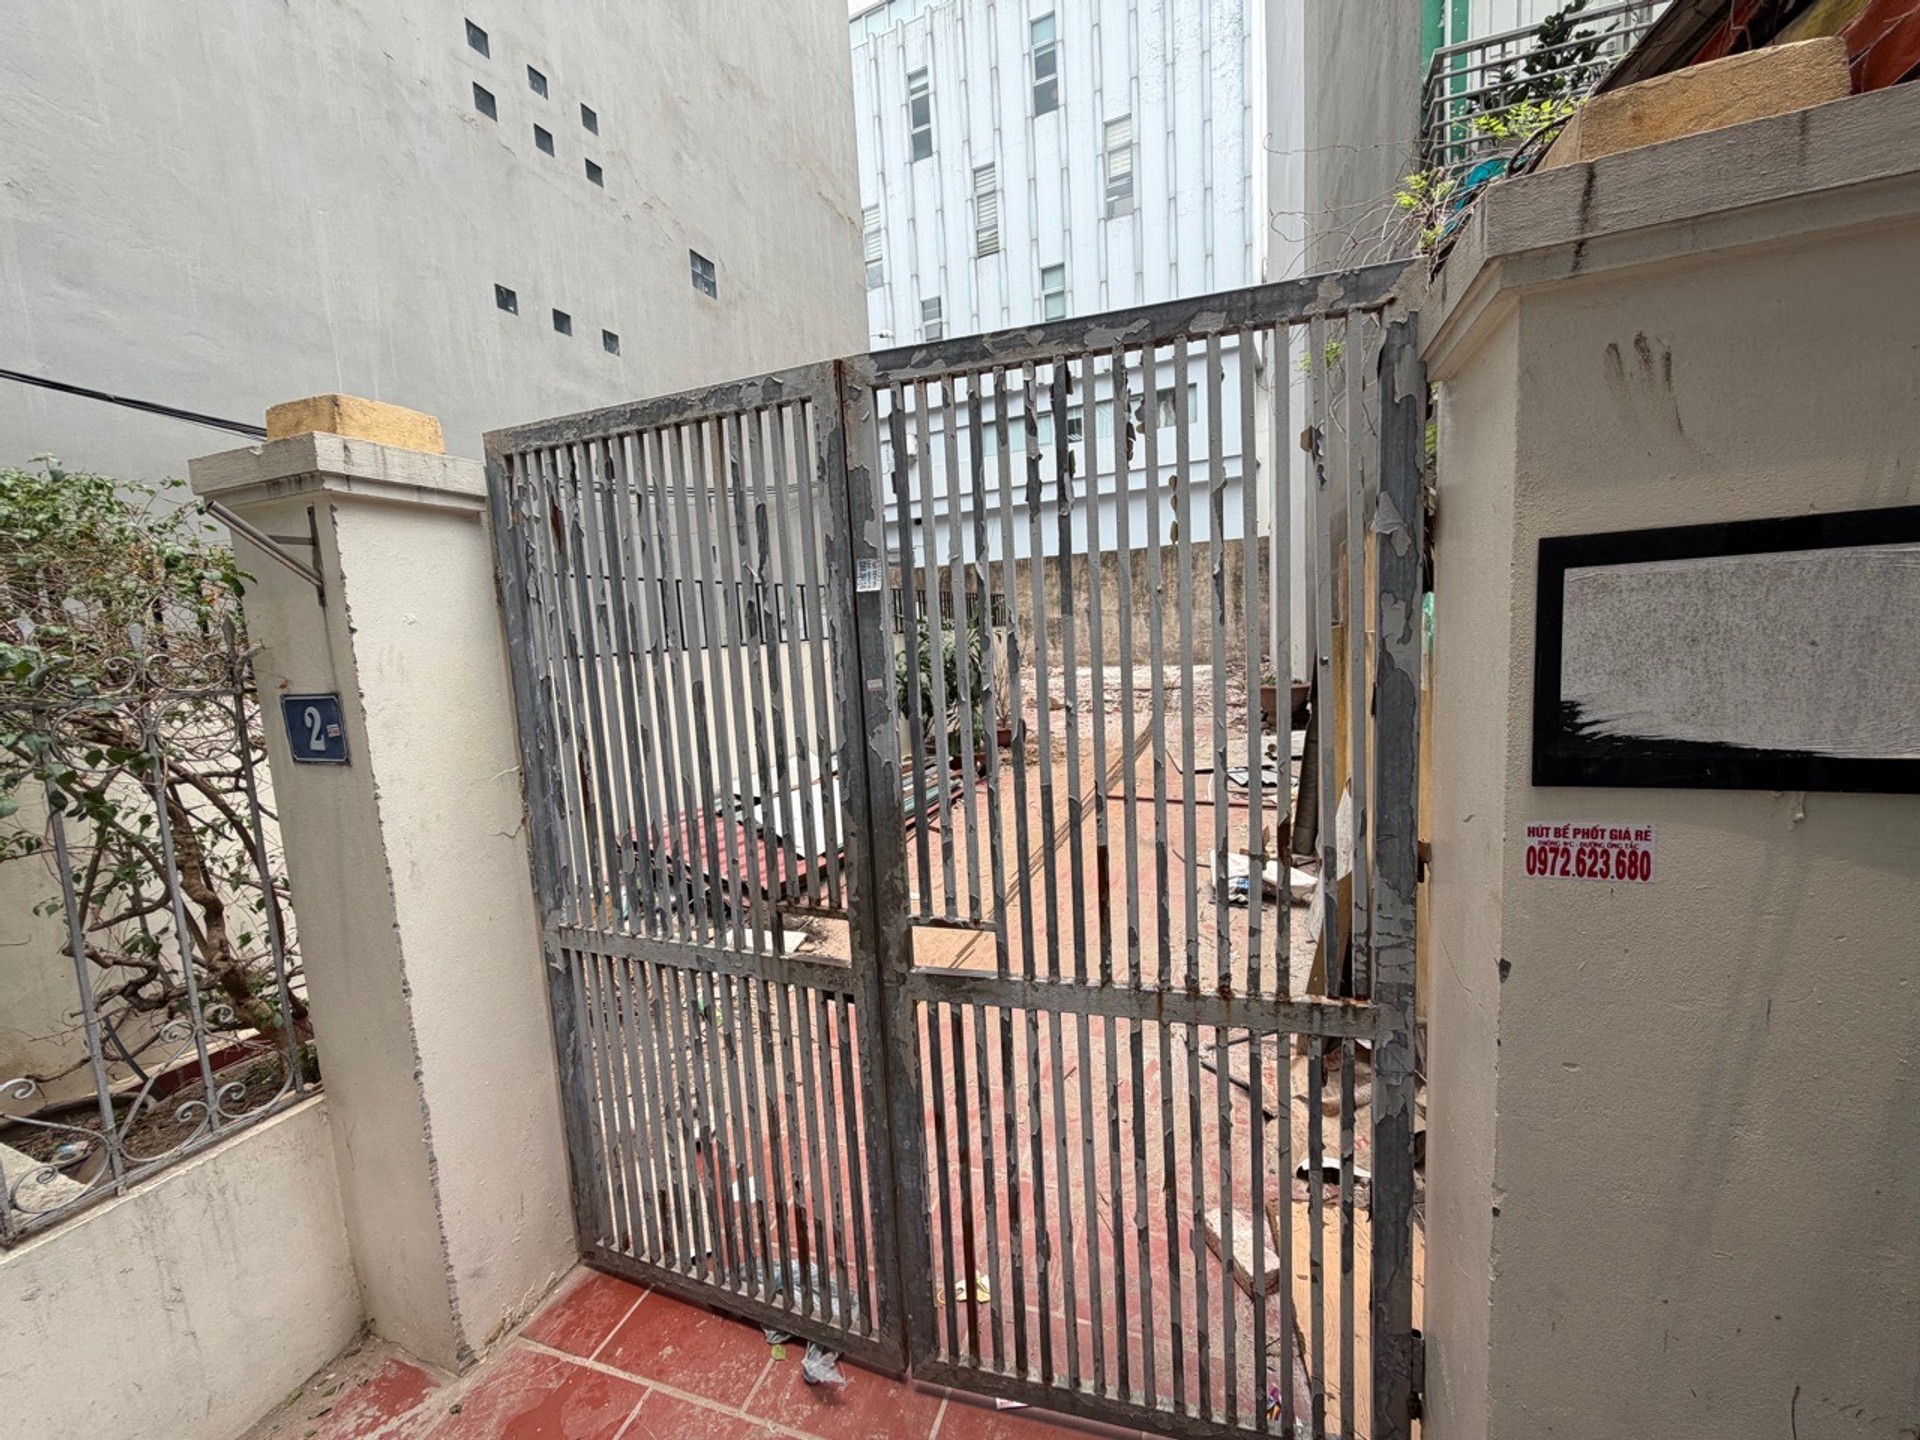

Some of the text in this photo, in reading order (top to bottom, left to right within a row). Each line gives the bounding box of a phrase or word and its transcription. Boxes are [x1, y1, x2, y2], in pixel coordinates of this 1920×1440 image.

[304, 706, 326, 751] 2
[1527, 824, 1551, 838] HÚT
[1573, 824, 1606, 840] PHỐT
[1609, 827, 1631, 841] GIÁ
[1635, 825, 1652, 842] RẺ
[1526, 845, 1651, 881] 0972.623.680
